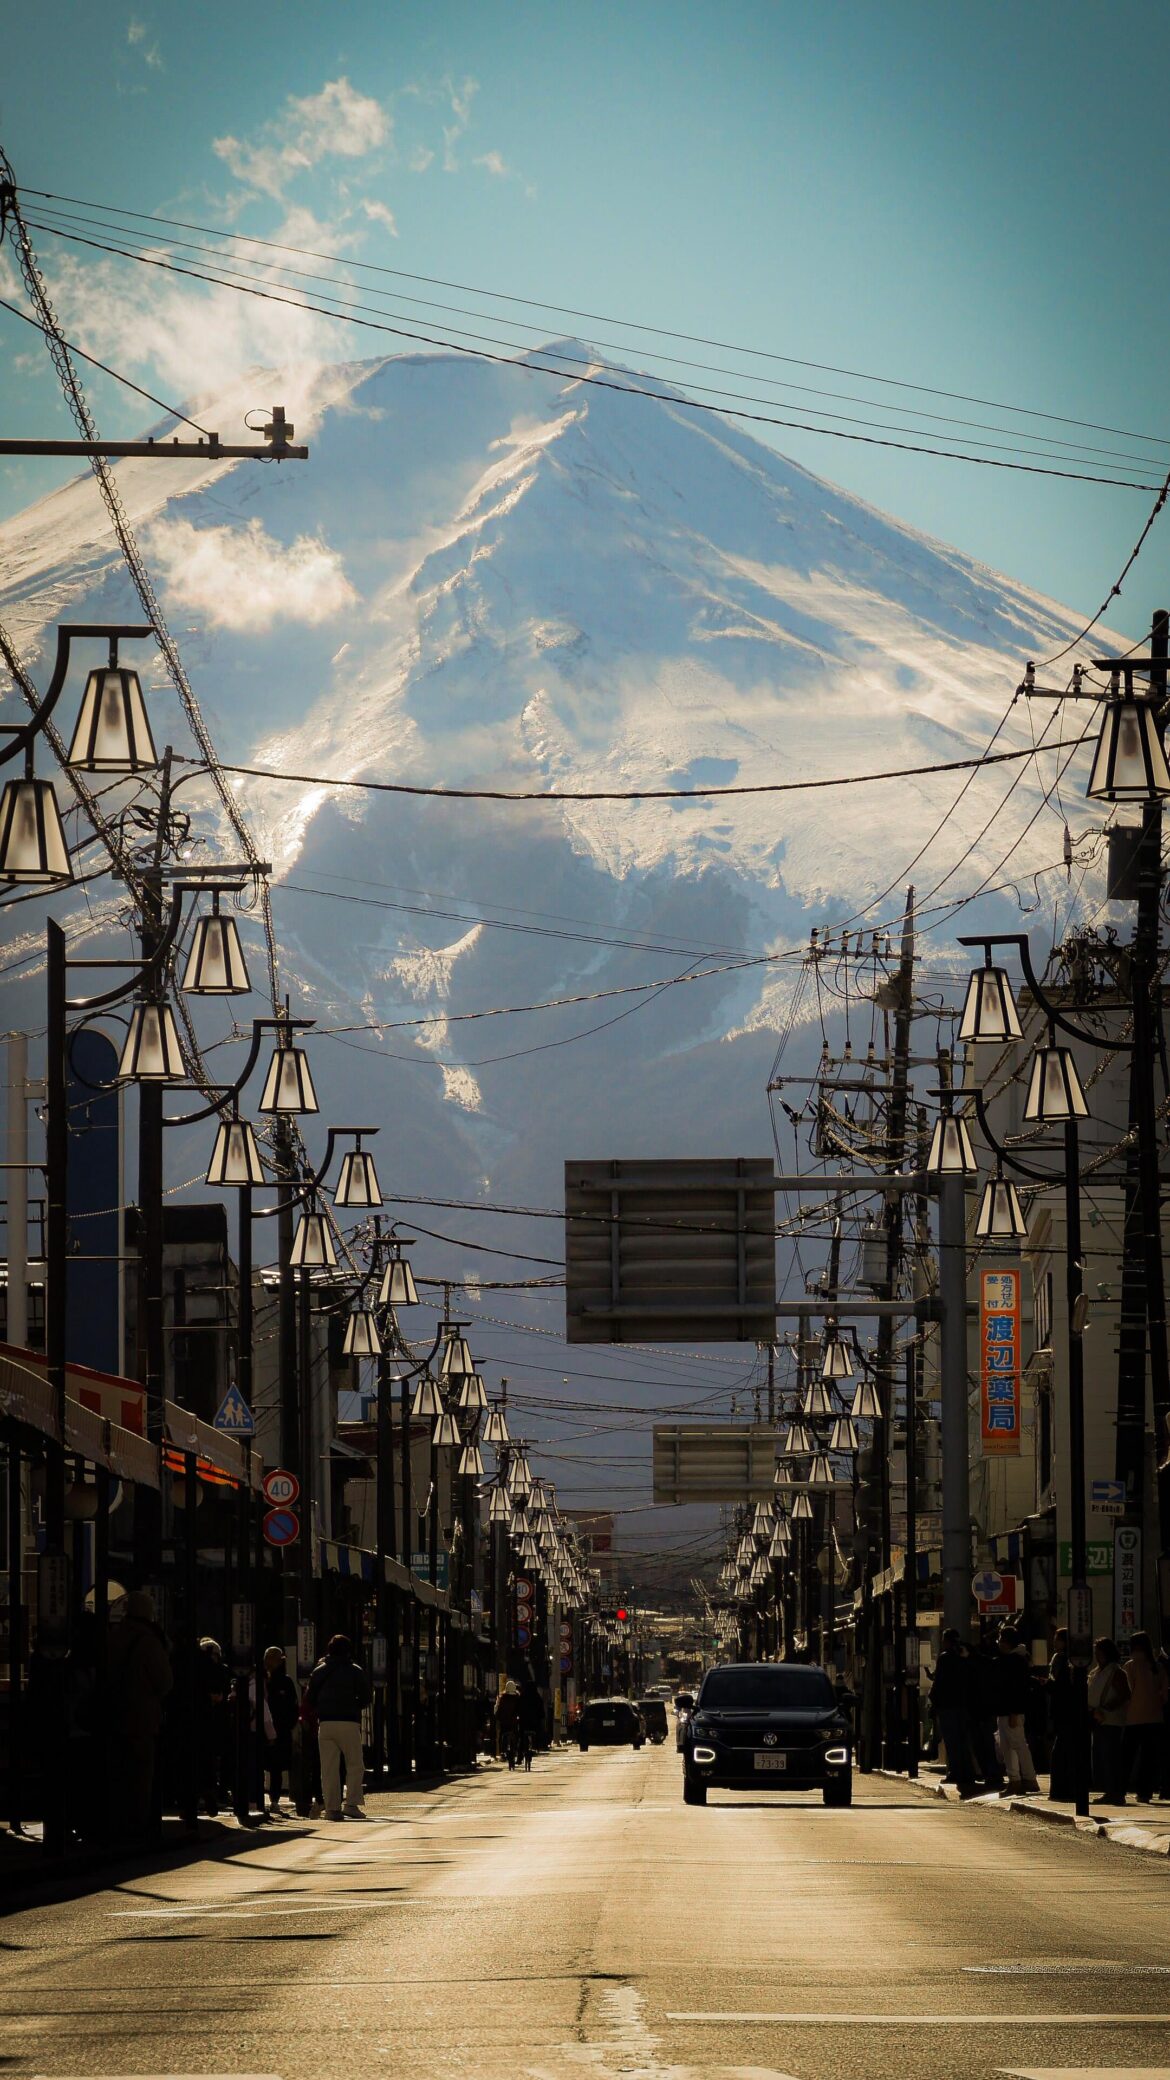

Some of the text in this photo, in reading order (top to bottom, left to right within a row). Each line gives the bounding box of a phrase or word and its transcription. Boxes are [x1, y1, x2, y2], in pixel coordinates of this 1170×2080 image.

[986, 1276, 998, 1308] 受付
[1000, 1275, 1013, 1308] 処方せん
[986, 1315, 1015, 1432] 渡辺薬局
[271, 1481, 290, 1497] 40
